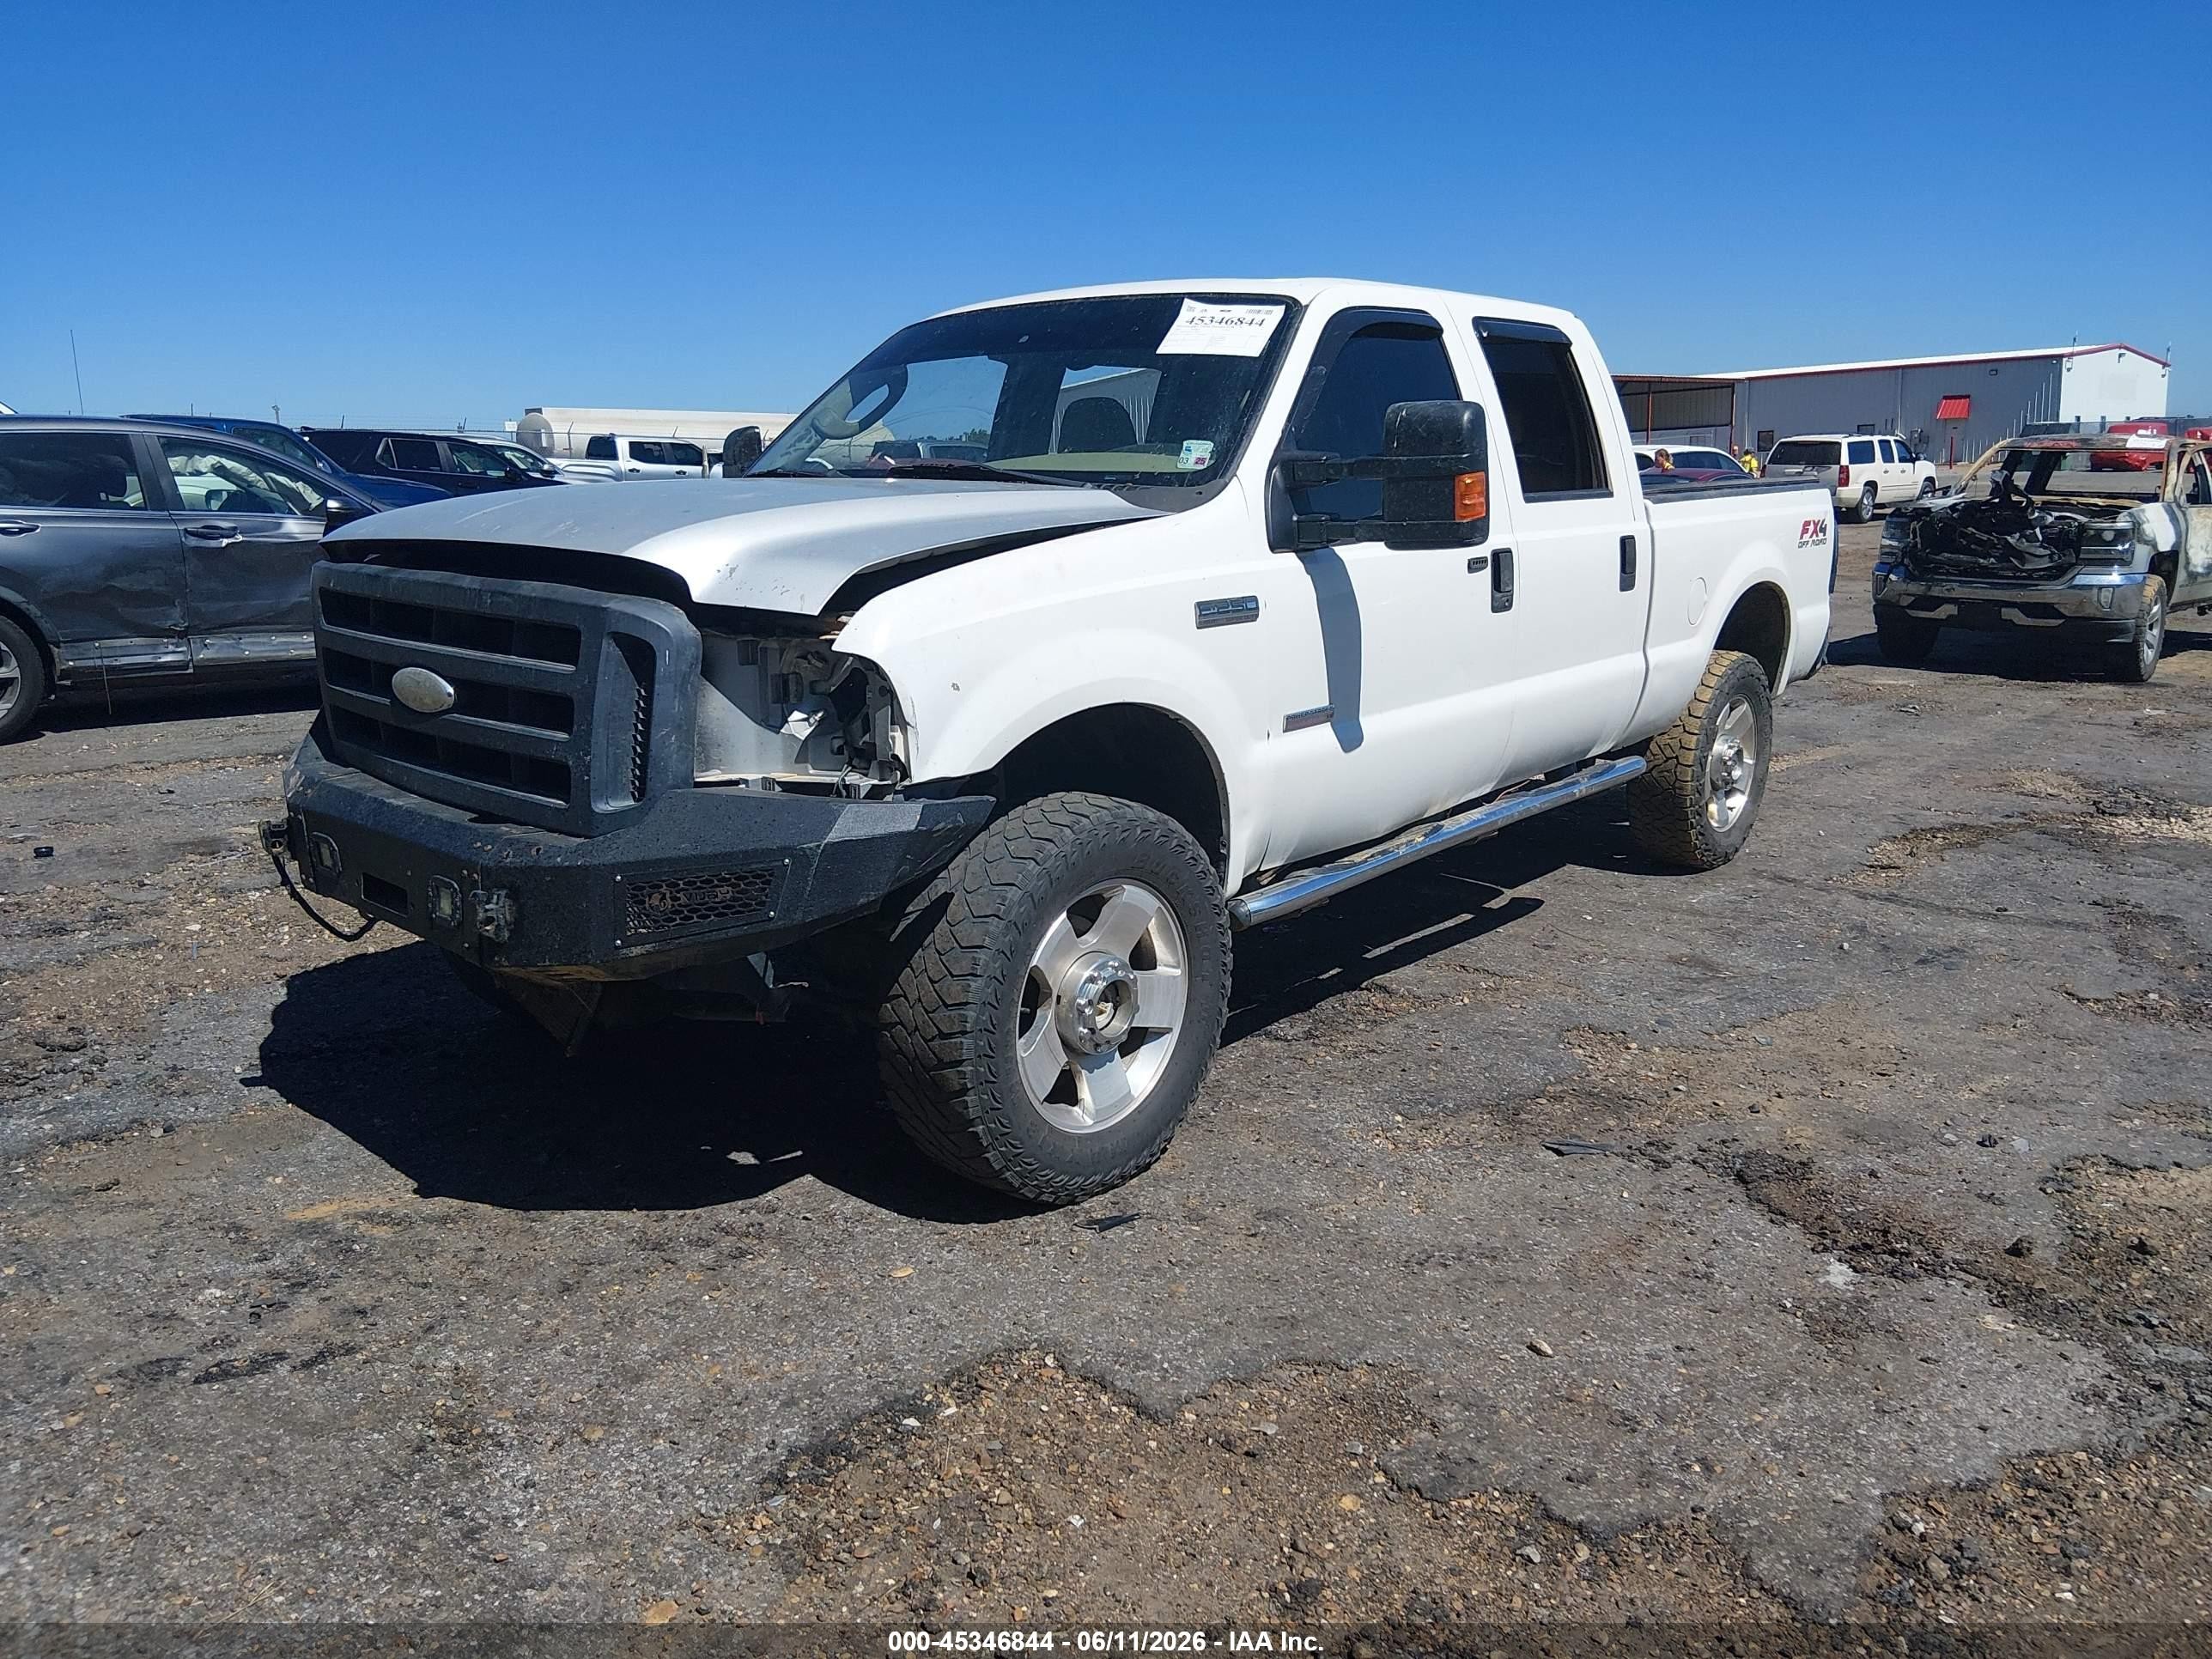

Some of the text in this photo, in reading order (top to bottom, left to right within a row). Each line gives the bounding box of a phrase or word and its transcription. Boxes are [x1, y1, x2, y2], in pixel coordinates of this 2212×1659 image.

[1185, 315, 1266, 328] 45346844
[1799, 518, 1828, 540] FX4
[1797, 538, 1827, 549] OFF ROAD
